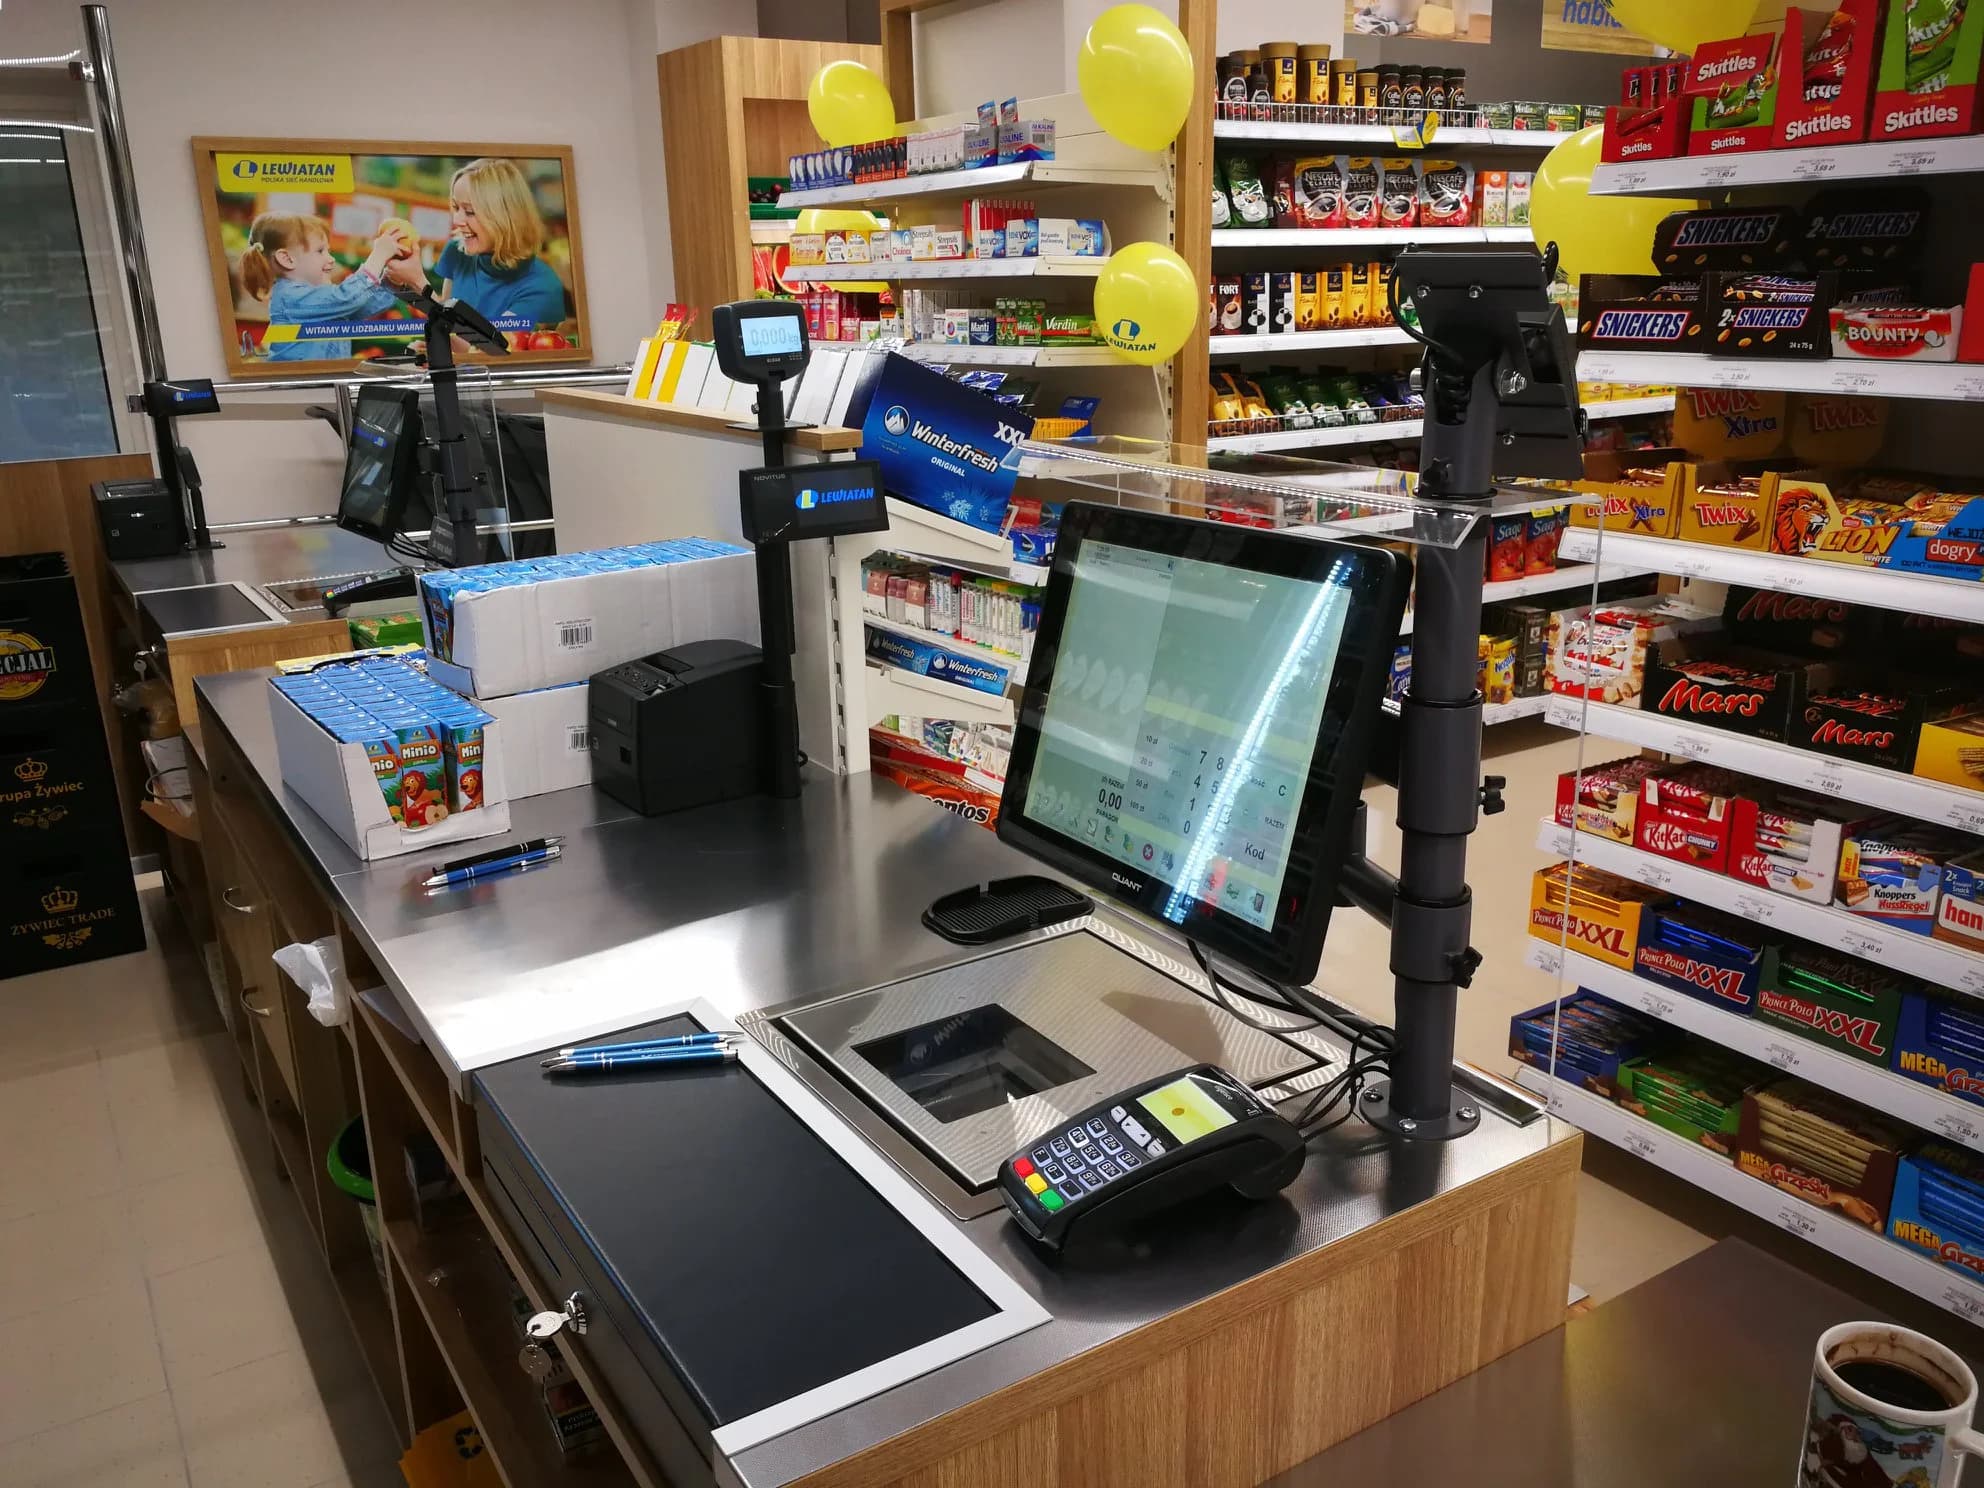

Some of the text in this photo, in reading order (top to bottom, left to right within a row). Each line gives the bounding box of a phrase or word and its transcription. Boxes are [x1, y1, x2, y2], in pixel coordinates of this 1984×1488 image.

[1697, 55, 1757, 82] Skittles
[1785, 114, 1851, 140] Skittles
[1885, 105, 1958, 132] Skittles
[1621, 143, 1652, 156] Skittles
[1711, 136, 1745, 150] Skittles
[262, 162, 335, 176] LEWIATAN
[1677, 216, 1776, 245] SNICKERS
[1829, 214, 1915, 238] SNICKERS
[305, 319, 530, 335] WITAMY W LIDZBARKU WARMI 21
[970, 321, 989, 332] Manti
[1045, 317, 1077, 330] Verdin
[1597, 313, 1685, 338] SNICKERS
[1718, 308, 1804, 327] 2x SNICKERS
[788, 334, 798, 346] kg
[1105, 334, 1156, 352] LEWIATAN
[1847, 327, 1920, 342] BOUNTY
[1687, 387, 1760, 418] Twix
[1725, 416, 1776, 438] Xtra
[1807, 402, 1880, 431] Twix
[910, 420, 1001, 474] Winterfresh
[930, 456, 966, 478] ORIGINAL
[754, 474, 786, 482] NOVITUS
[821, 487, 875, 504] LEWIATAN
[1634, 502, 1665, 521] Xtra
[1695, 501, 1748, 526] Twix
[1820, 525, 1901, 554] LION
[1930, 539, 1976, 561] dogry
[1864, 554, 1892, 564] WHITE
[1736, 590, 1848, 622] Mars
[881, 637, 915, 659] Winterfresh
[0, 651, 52, 675] CJAL
[948, 659, 999, 682] Winterfresh
[1659, 678, 1764, 717] Mars
[1811, 718, 1894, 748] Mars
[401, 743, 437, 760] Minio
[461, 744, 482, 758] Min
[1199, 750, 1207, 765] 7
[372, 759, 394, 772] nio
[1216, 757, 1224, 771] 8
[0, 780, 85, 804] rupa Żywiec
[1194, 774, 1201, 789] 4
[1211, 781, 1218, 795] 5
[1278, 784, 1287, 797] C
[926, 797, 990, 823] ntos
[1098, 788, 1122, 811] 0,00
[1189, 797, 1195, 812] 1
[1183, 820, 1191, 834] 0
[1648, 824, 1685, 849] KitKat
[1245, 841, 1265, 861] Kod
[1688, 835, 1717, 849] CHUNKY
[1743, 856, 1772, 874] KitKat
[1111, 871, 1142, 892] QUANT
[1945, 870, 1959, 882] 2x
[1874, 887, 1916, 900] Knoppers
[11, 907, 114, 937] ŻYWIEC TRADE
[1945, 899, 1984, 930] han
[1577, 920, 1631, 958] XXL
[1640, 949, 1664, 965] PRINCE
[1664, 953, 1684, 970] POLO
[1686, 959, 1750, 1004] XXL
[1761, 991, 1886, 1056] PRINCE POLO XXL
[1900, 1050, 1948, 1076] MEGA
[1740, 1151, 1770, 1172] MEGA
[1894, 1219, 1942, 1250] MEGA
